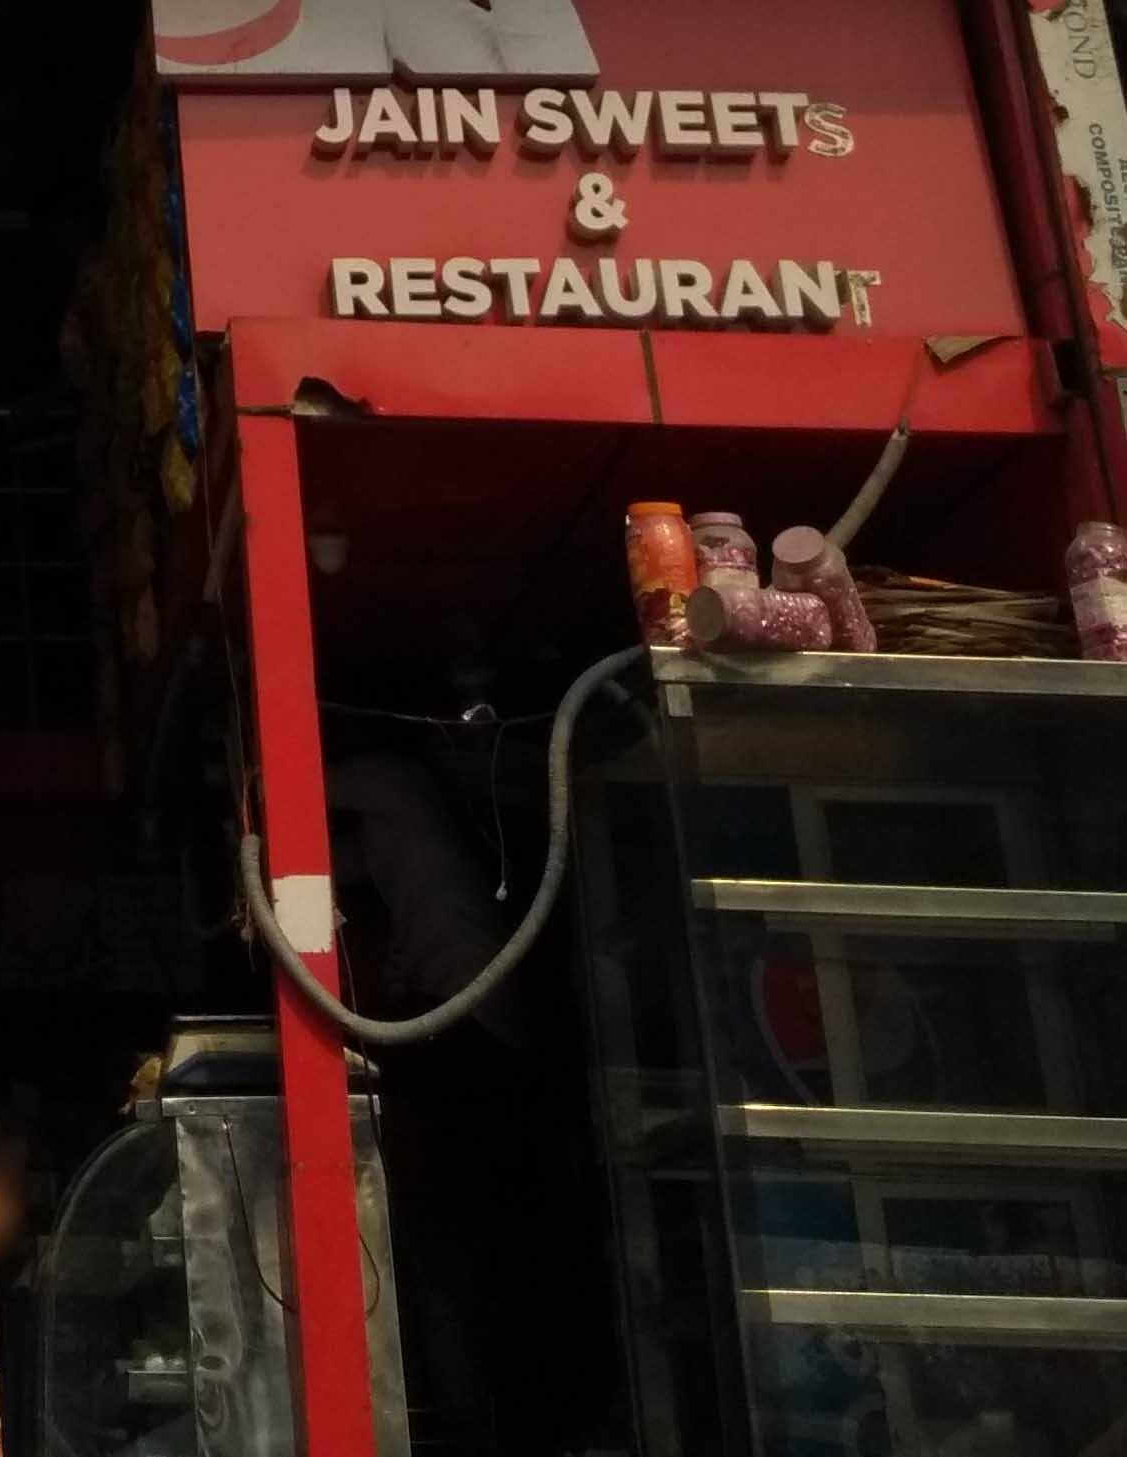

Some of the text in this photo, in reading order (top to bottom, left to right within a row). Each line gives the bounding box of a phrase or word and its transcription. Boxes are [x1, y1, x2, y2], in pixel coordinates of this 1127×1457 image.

[314, 87, 855, 158] JAIN SWEETS
[570, 172, 629, 239] &
[330, 256, 881, 331] RESTAURANT
